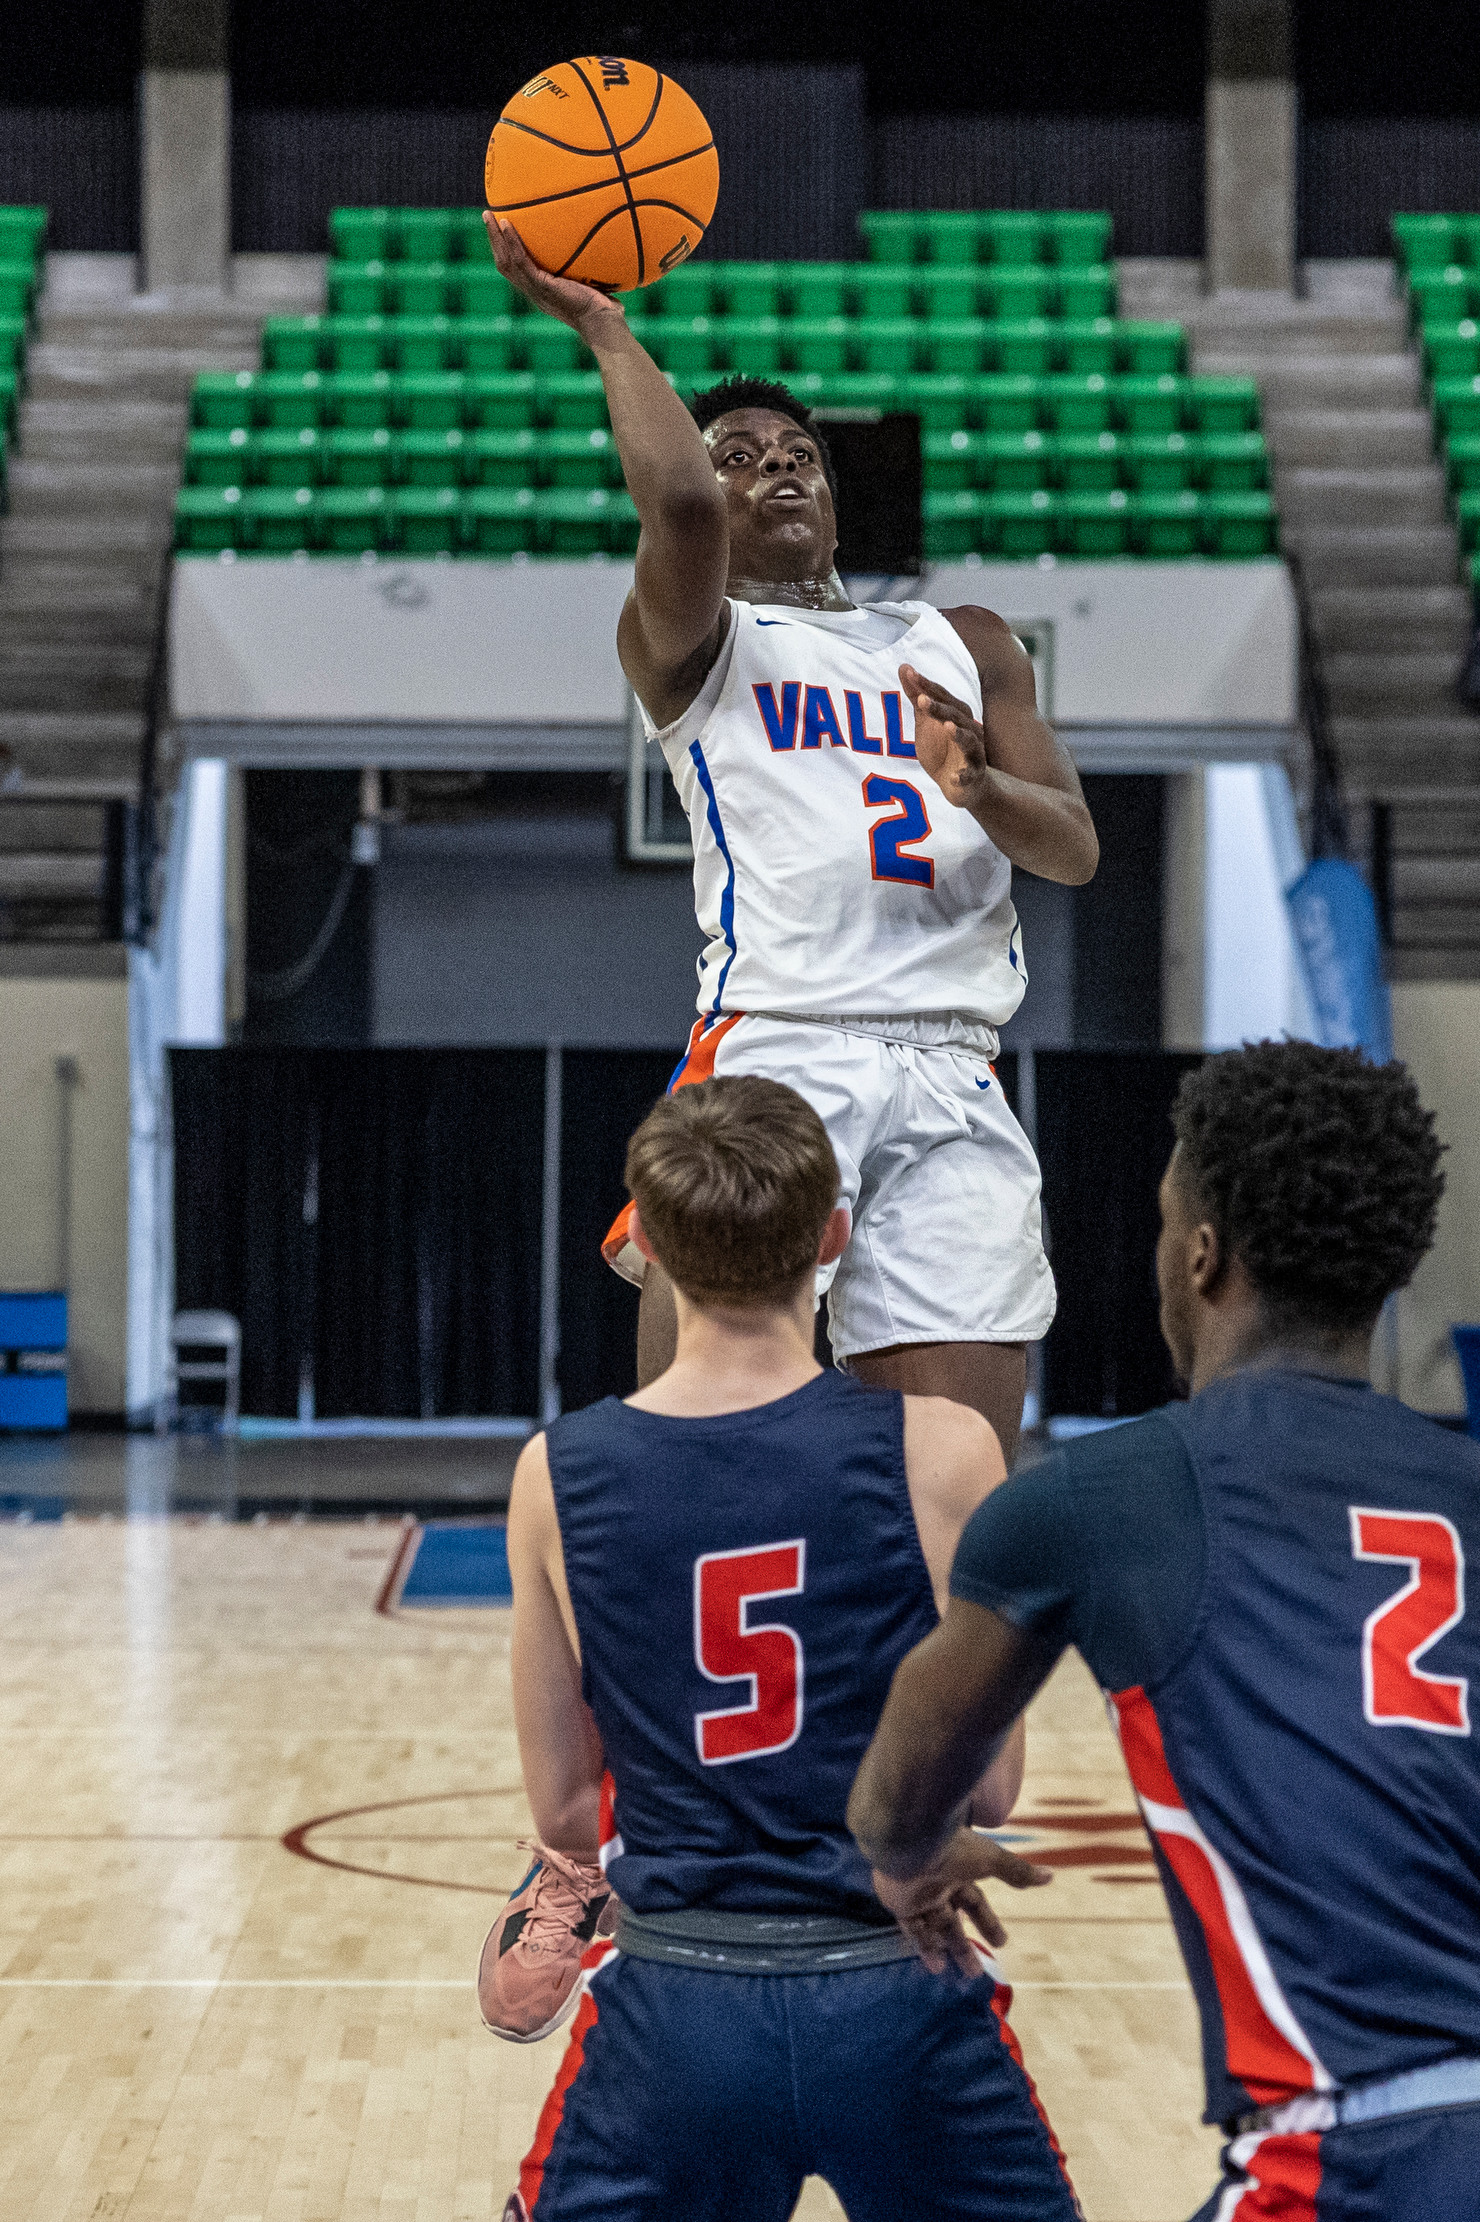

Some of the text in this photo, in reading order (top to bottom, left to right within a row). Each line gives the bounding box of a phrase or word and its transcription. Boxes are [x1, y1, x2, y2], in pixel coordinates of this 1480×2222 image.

[751, 680, 918, 760] VALL
[861, 772, 935, 890] 2
[693, 1538, 805, 1766] 5
[1348, 1506, 1471, 1736] 2
